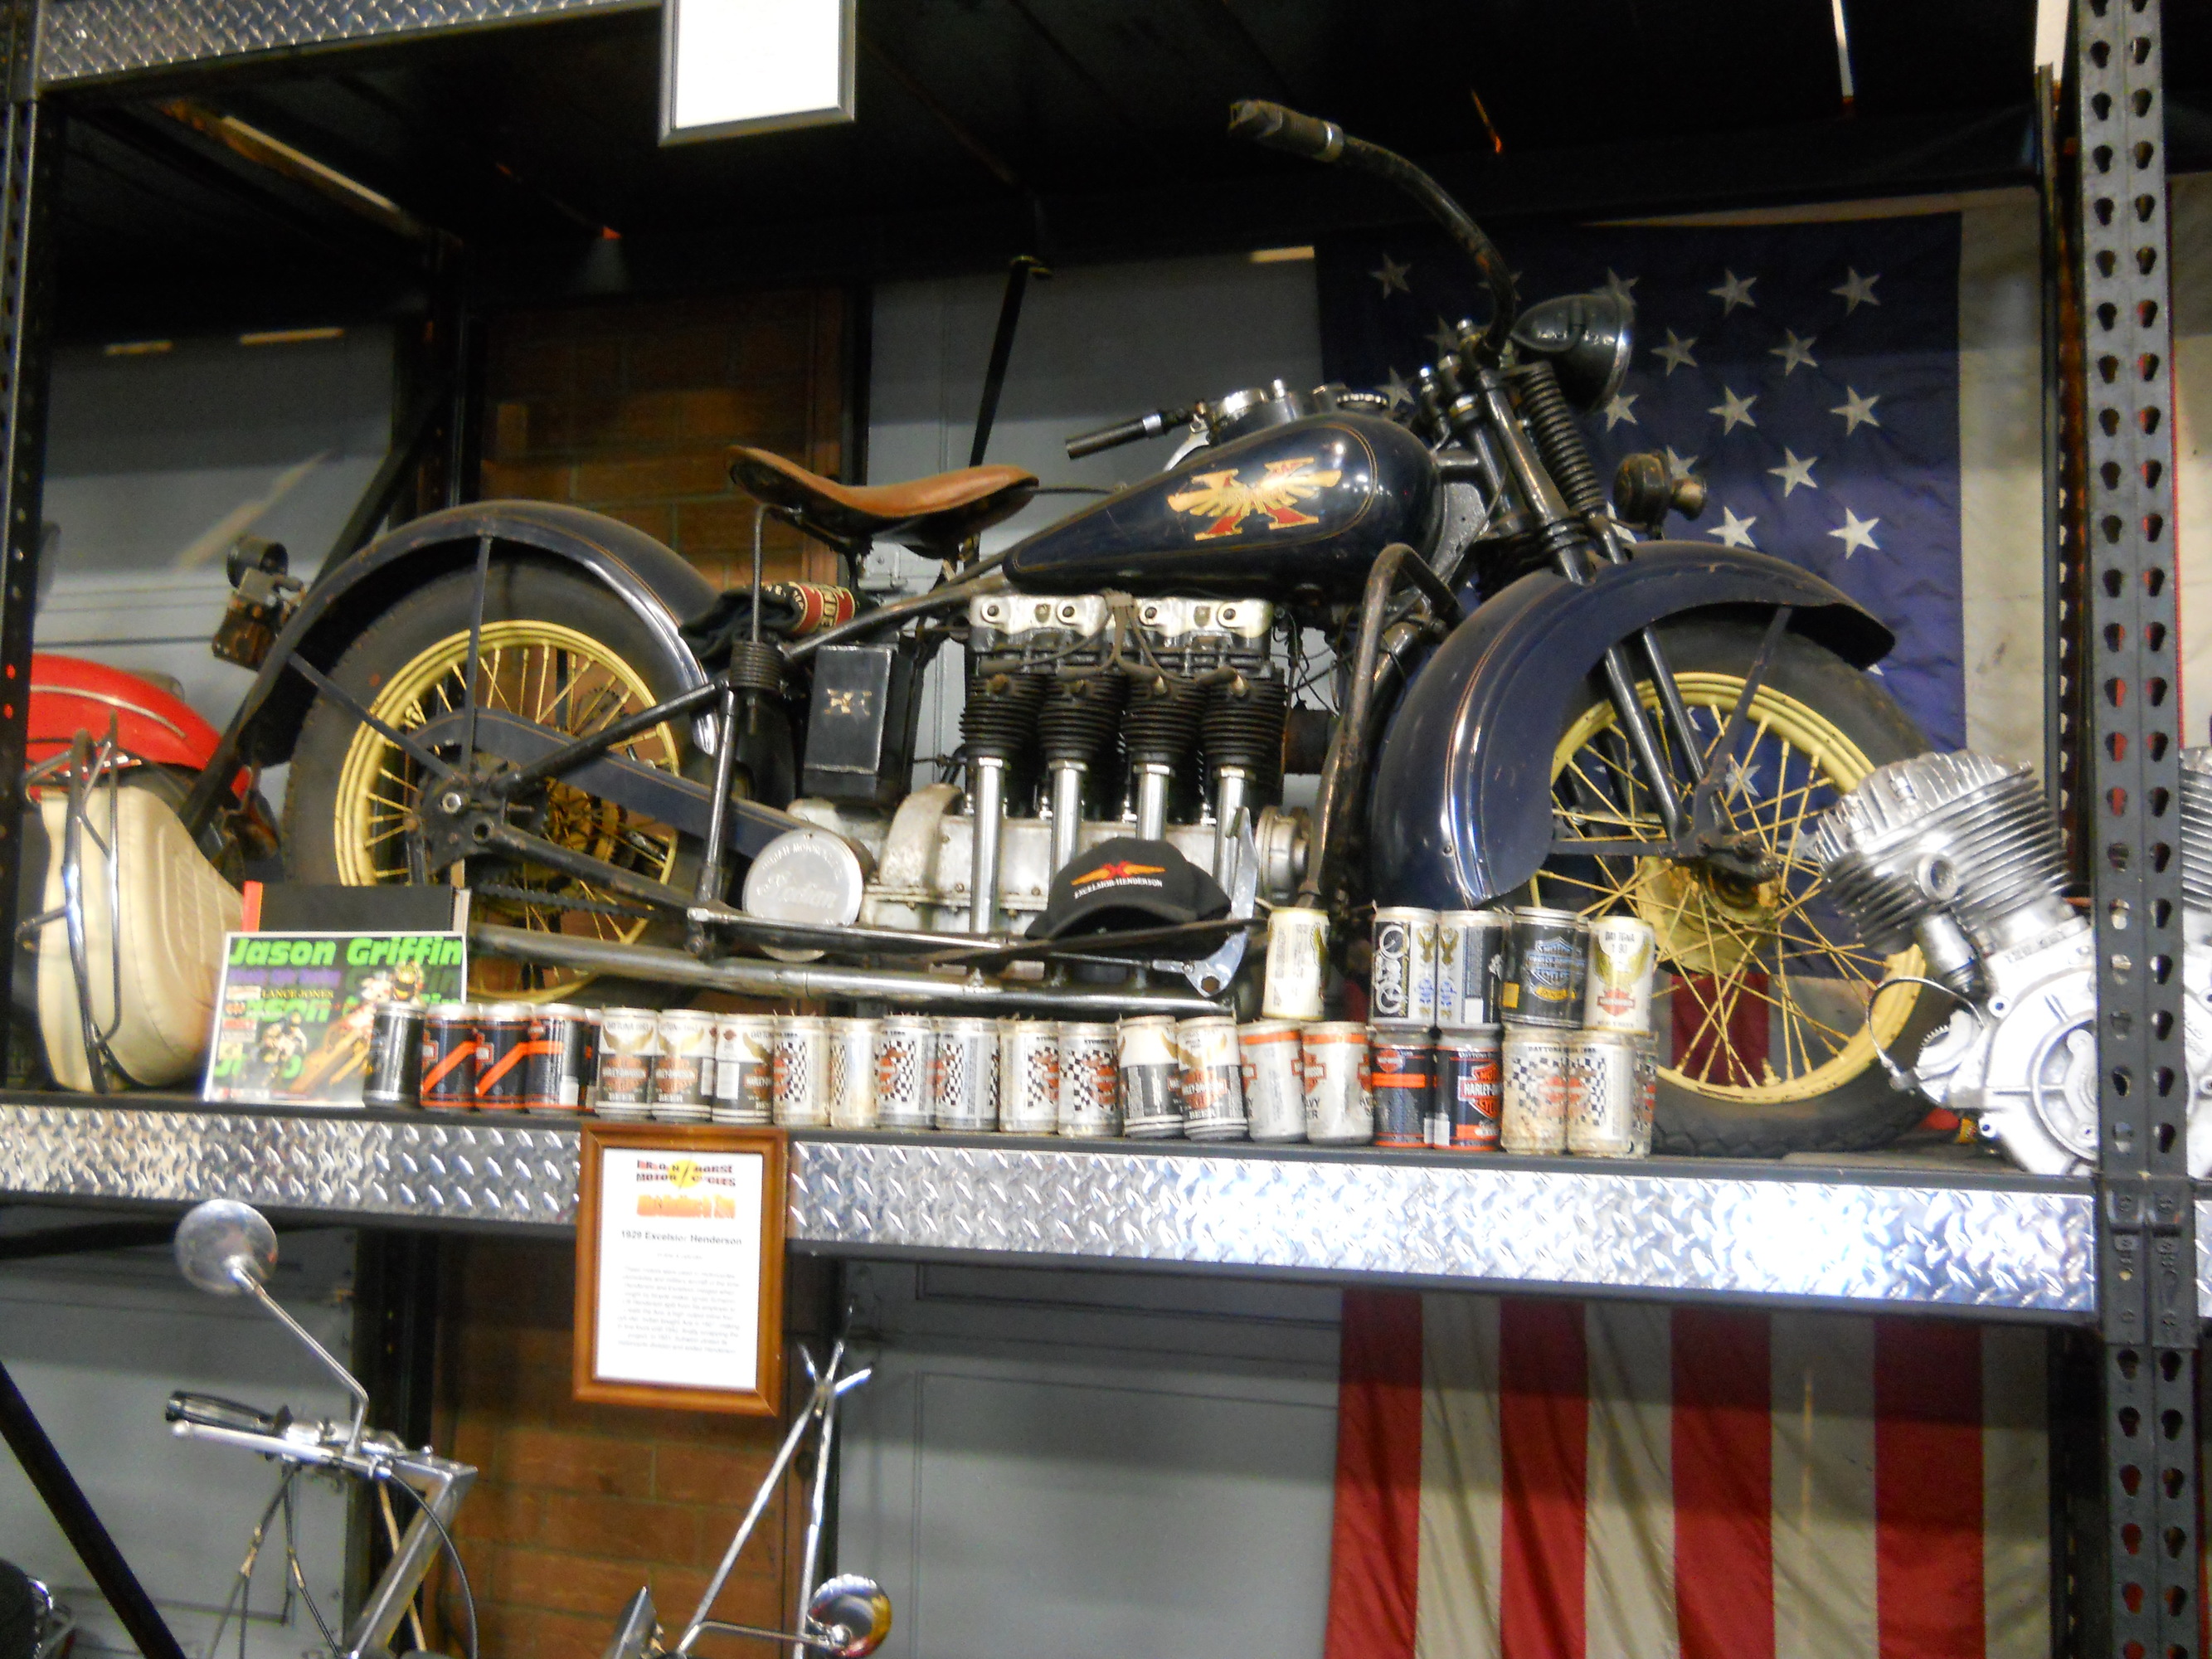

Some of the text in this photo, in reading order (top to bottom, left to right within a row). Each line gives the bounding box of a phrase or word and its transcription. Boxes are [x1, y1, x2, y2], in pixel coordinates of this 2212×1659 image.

[228, 936, 464, 967] Jason Griffin
[620, 1229, 743, 1246] 1929 Excelsior Henderson
